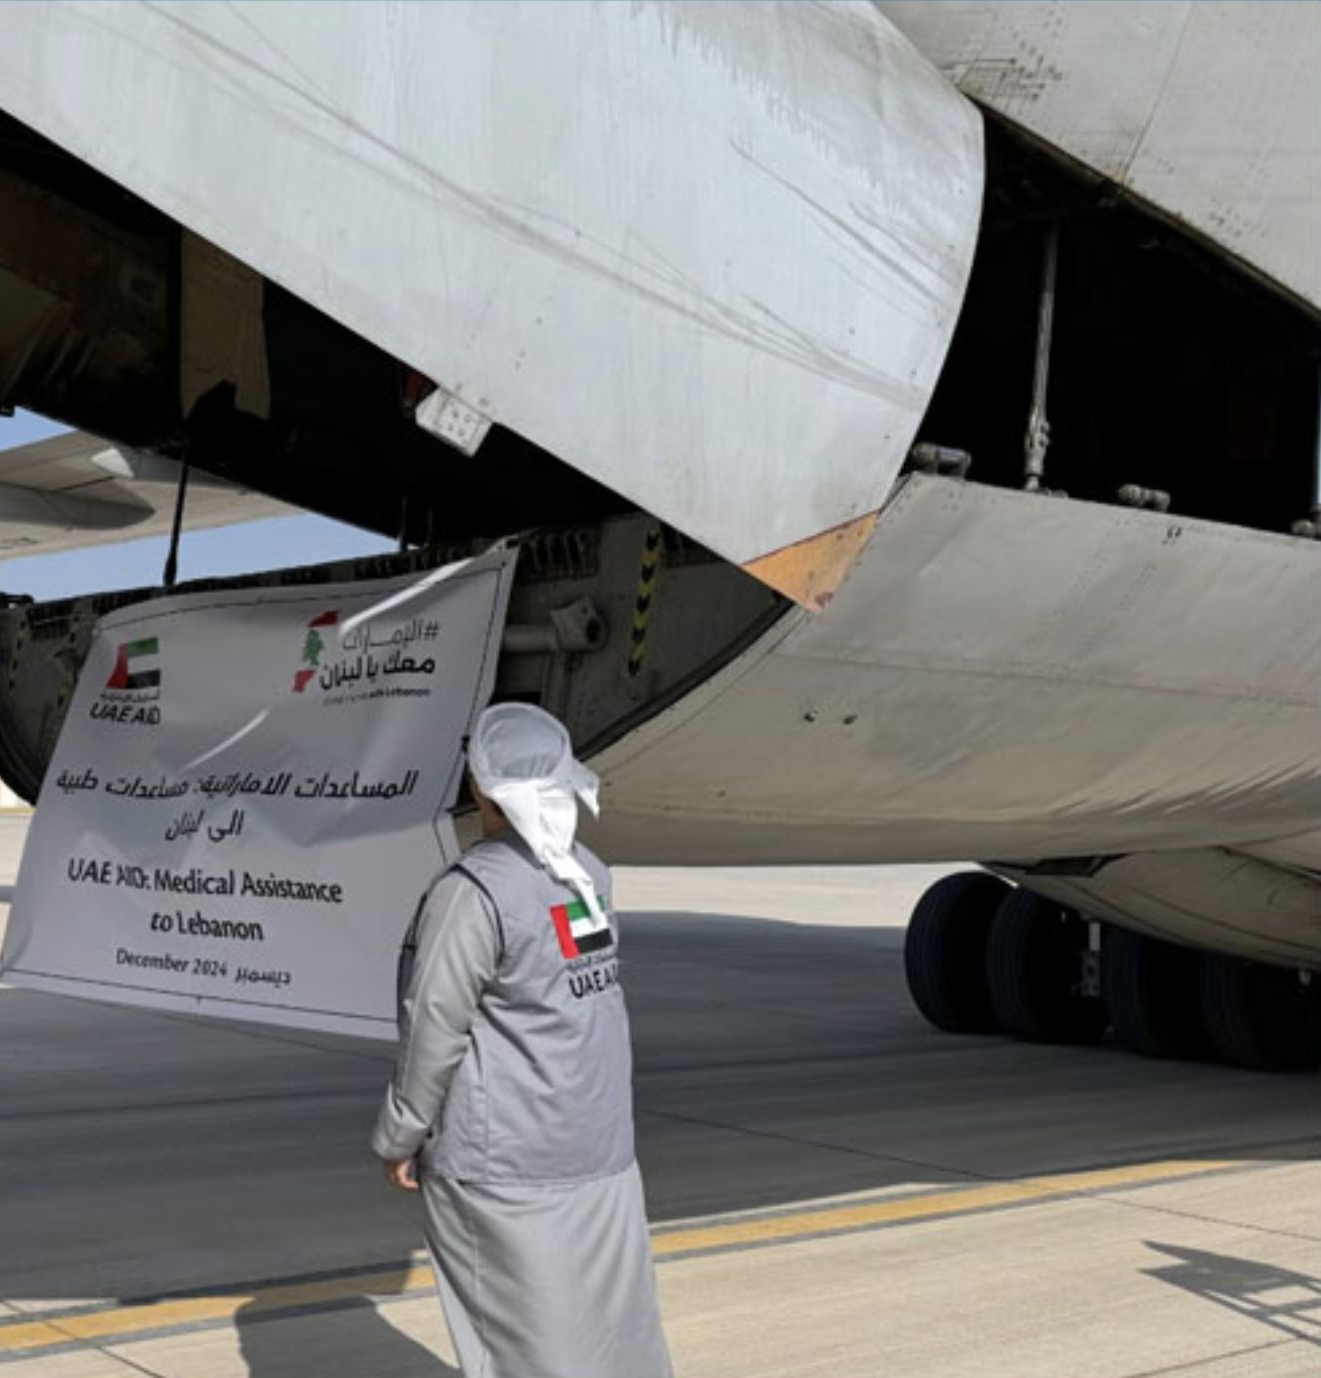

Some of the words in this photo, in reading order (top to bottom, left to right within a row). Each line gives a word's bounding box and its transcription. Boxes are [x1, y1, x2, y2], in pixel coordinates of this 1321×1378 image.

[319, 655, 363, 690] لبنان
[382, 650, 436, 675] معك
[89, 702, 134, 723] UAE
[56, 768, 99, 796] طبية
[105, 775, 190, 799] مساعدات
[294, 769, 419, 799] المساعدات
[165, 808, 205, 841] لبنان
[67, 858, 112, 885] UAE
[154, 868, 234, 895] Medical
[240, 871, 343, 903] Assistance
[150, 911, 174, 932] to
[176, 910, 264, 941] Lebanon
[116, 947, 189, 973] December
[192, 958, 228, 977] 2024
[234, 967, 292, 989] ديسمبر
[569, 970, 605, 999] UAE
